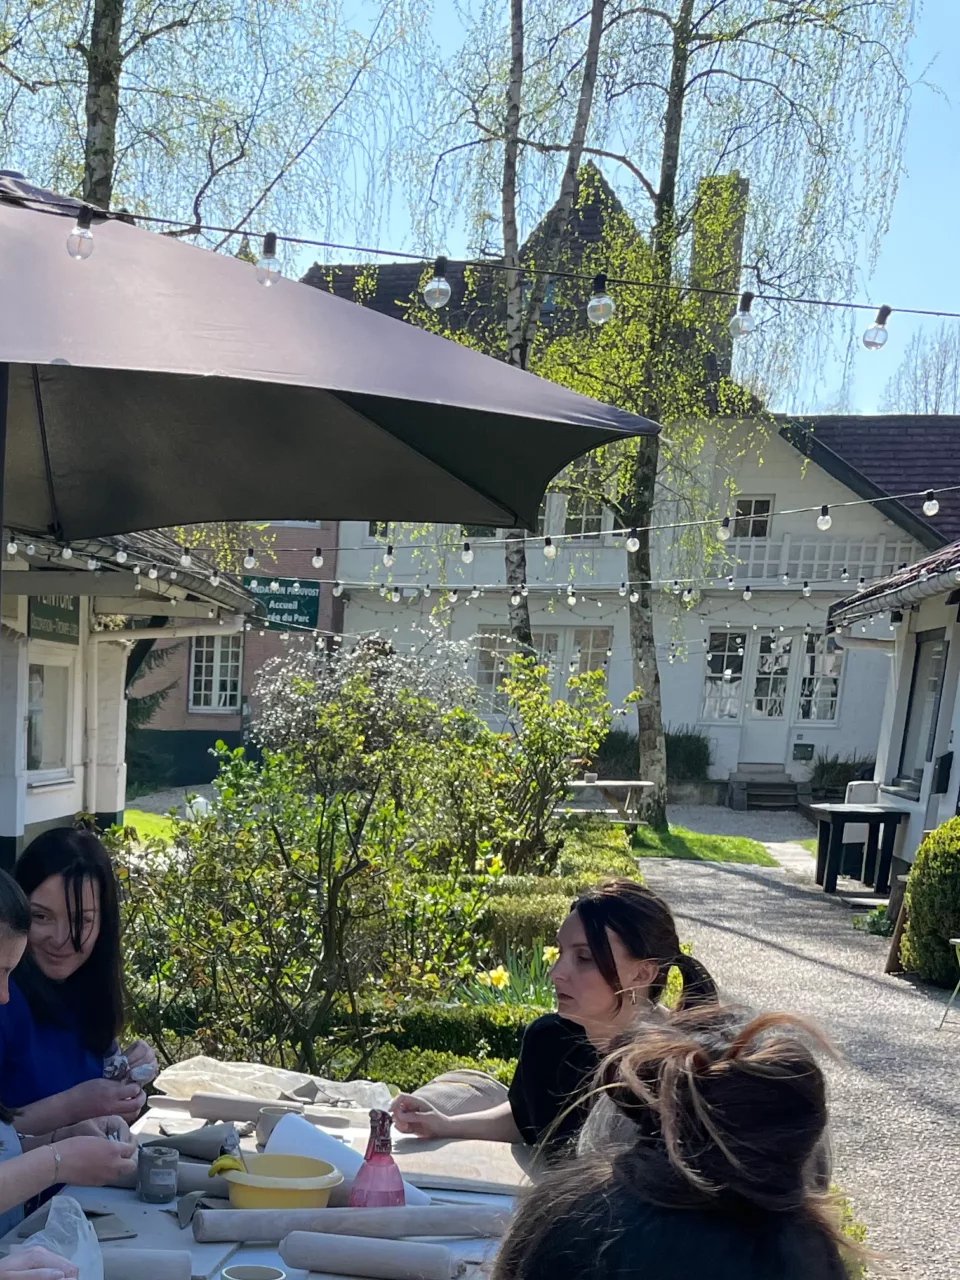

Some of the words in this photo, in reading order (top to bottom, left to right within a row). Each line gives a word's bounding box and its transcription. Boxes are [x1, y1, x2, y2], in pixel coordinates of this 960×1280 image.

[269, 600, 298, 609] Accueil
[282, 613, 293, 622] du
[293, 613, 310, 623] Parc
